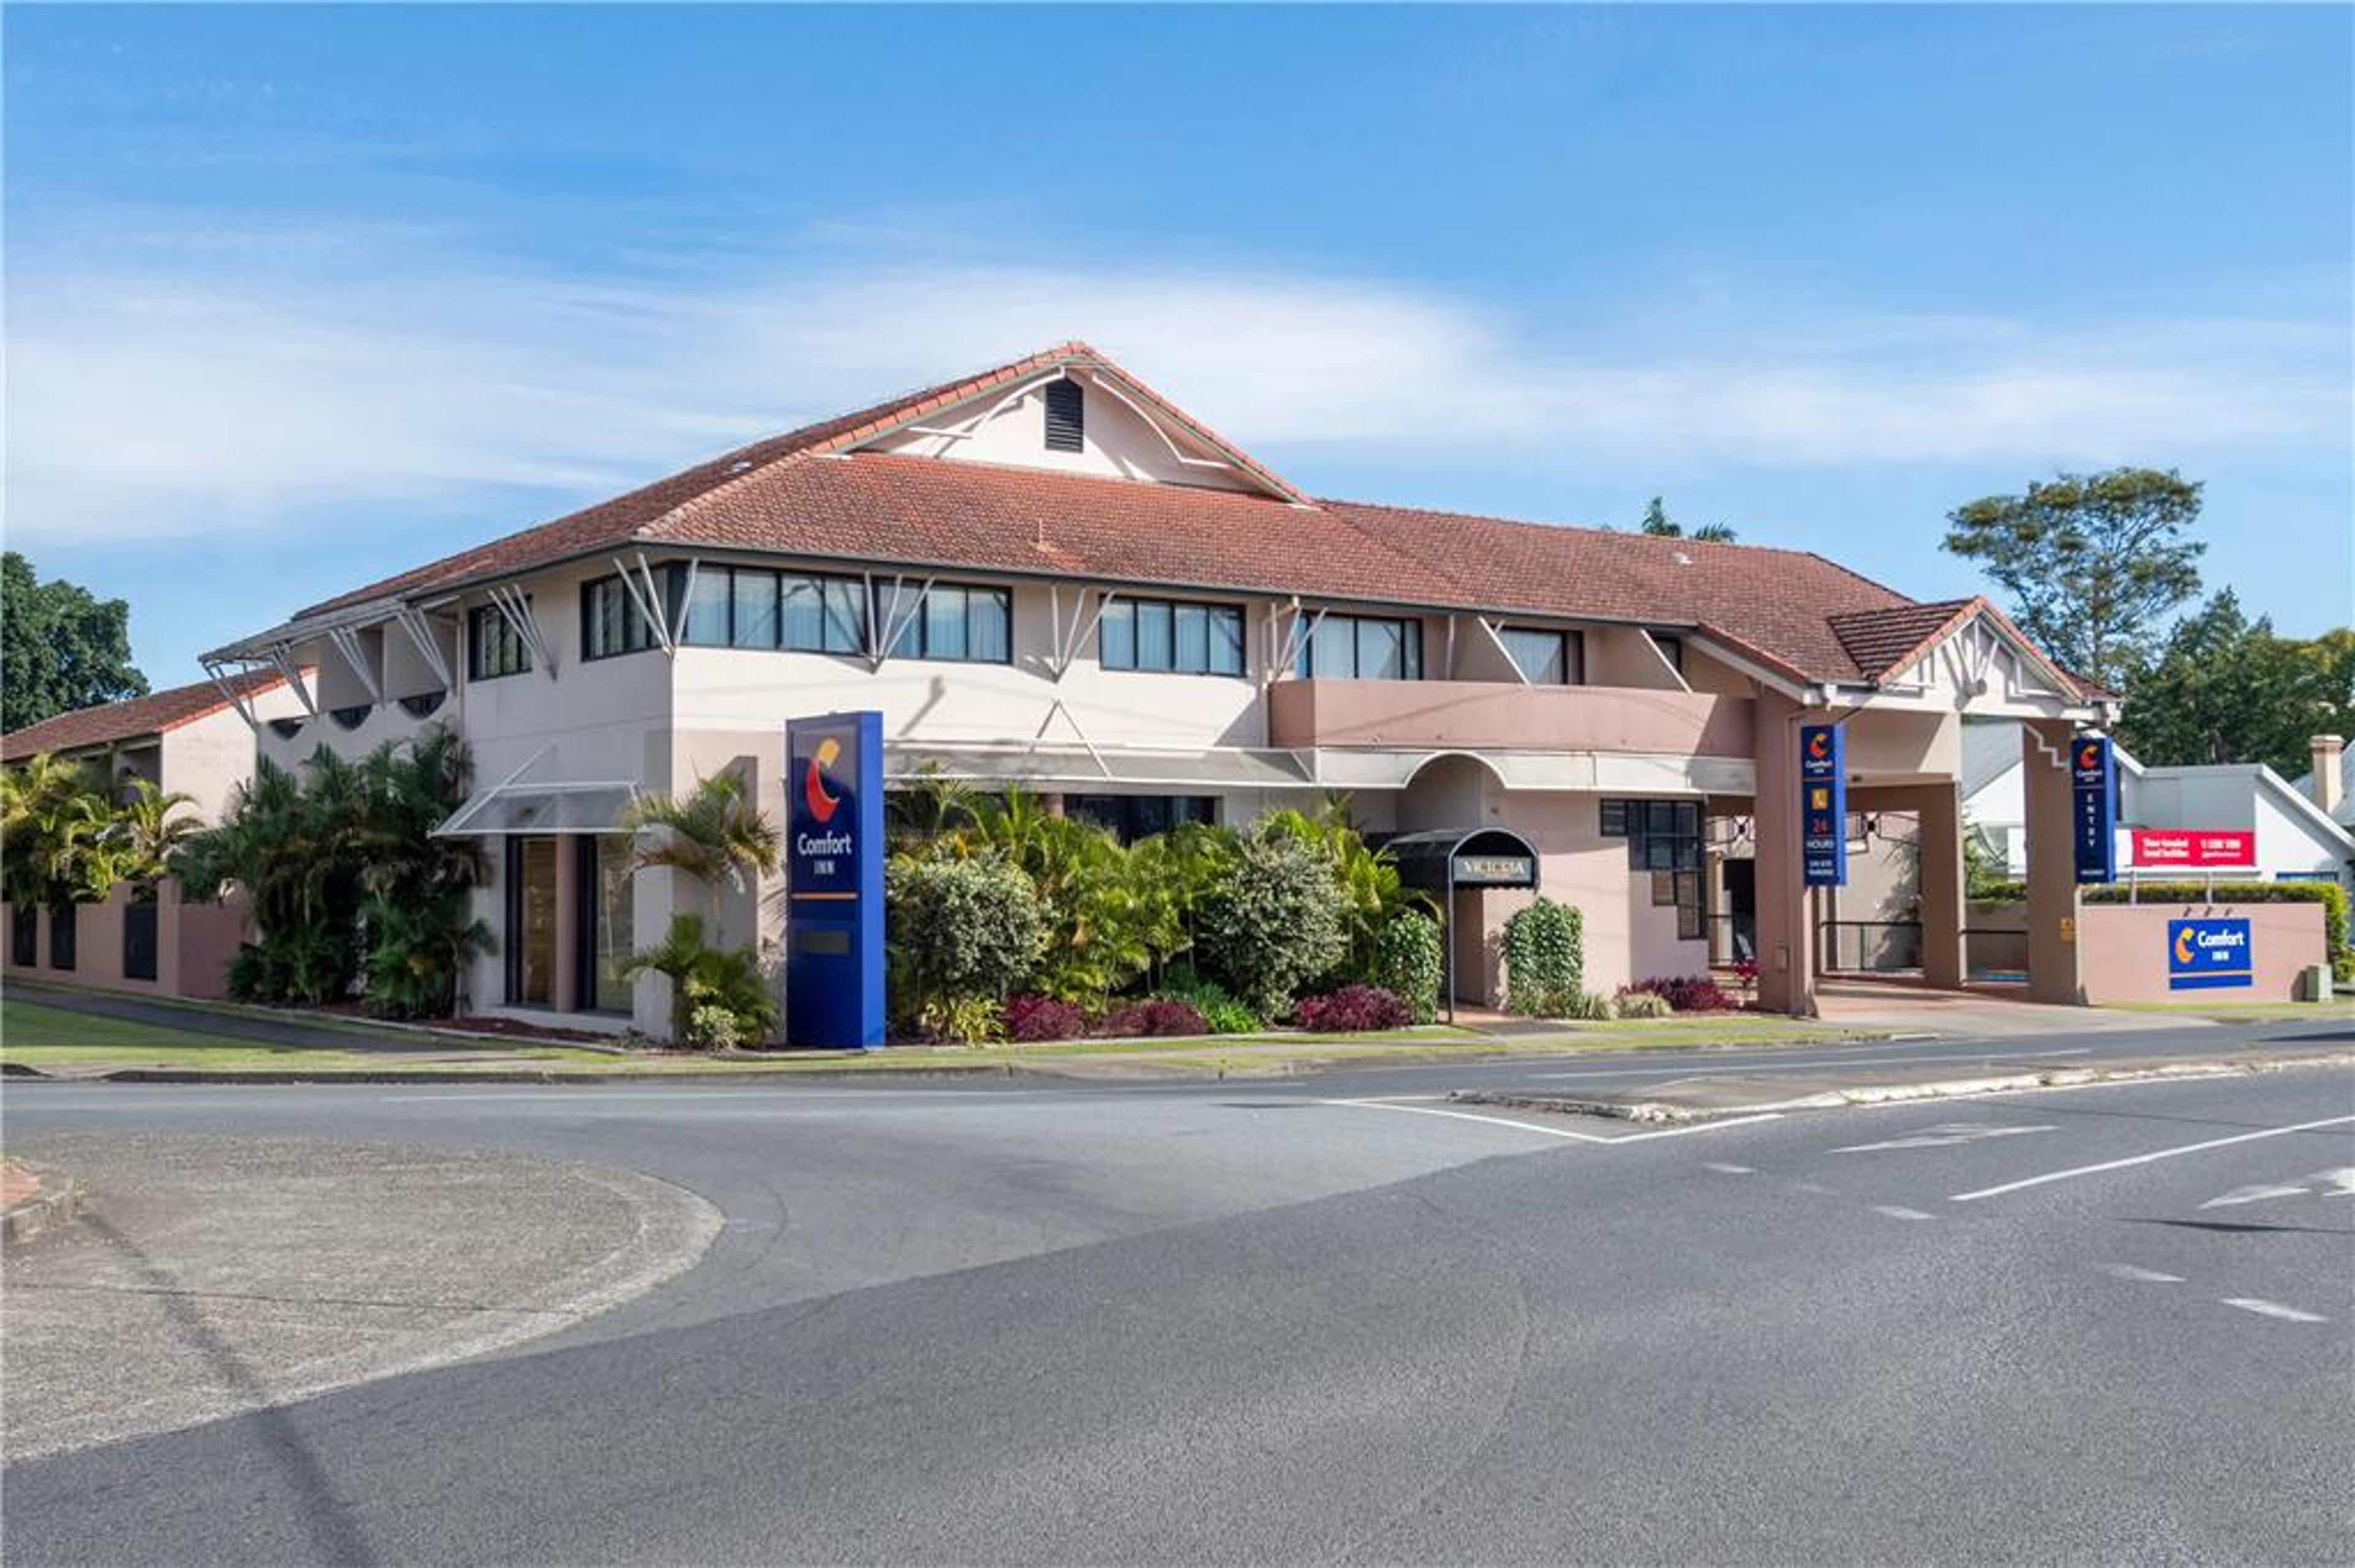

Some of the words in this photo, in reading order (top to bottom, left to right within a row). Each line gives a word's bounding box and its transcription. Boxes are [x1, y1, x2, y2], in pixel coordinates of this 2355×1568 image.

[798, 830, 851, 855] Comfort
[813, 860, 835, 874] INN
[2197, 928, 2245, 947] Comfort
